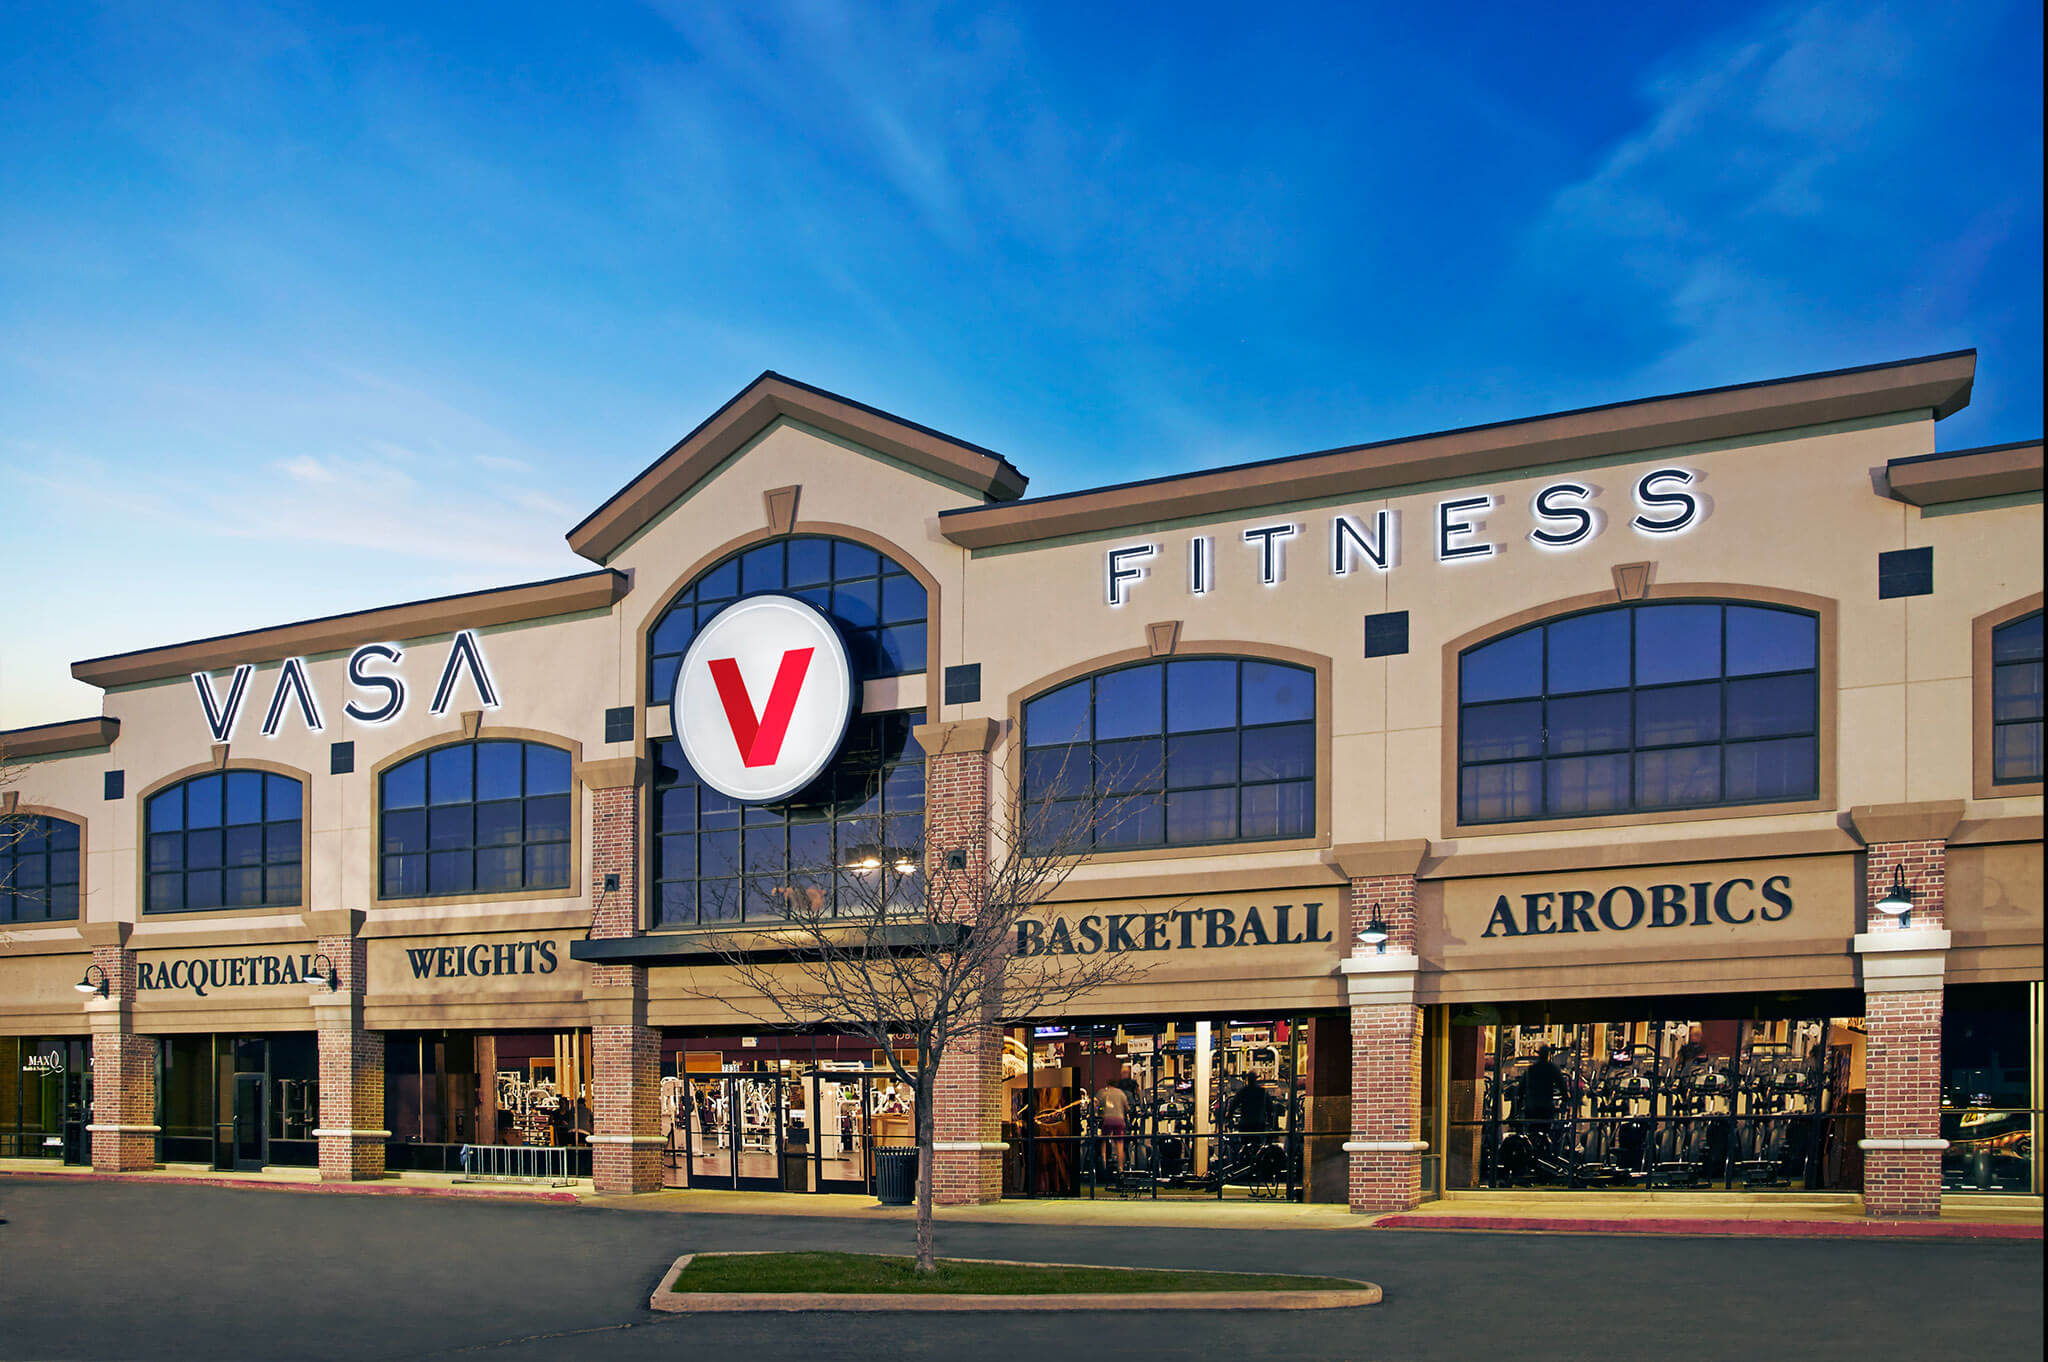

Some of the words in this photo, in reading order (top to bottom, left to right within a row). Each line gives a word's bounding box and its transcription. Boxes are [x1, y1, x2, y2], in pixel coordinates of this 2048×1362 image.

[1108, 468, 1698, 606] FITNESS
[191, 631, 500, 743] VASA
[707, 647, 815, 768] V
[1014, 902, 1333, 958] BASKETBALL
[1481, 875, 1793, 938] AEROBICS
[406, 939, 558, 979] WEIGHTS
